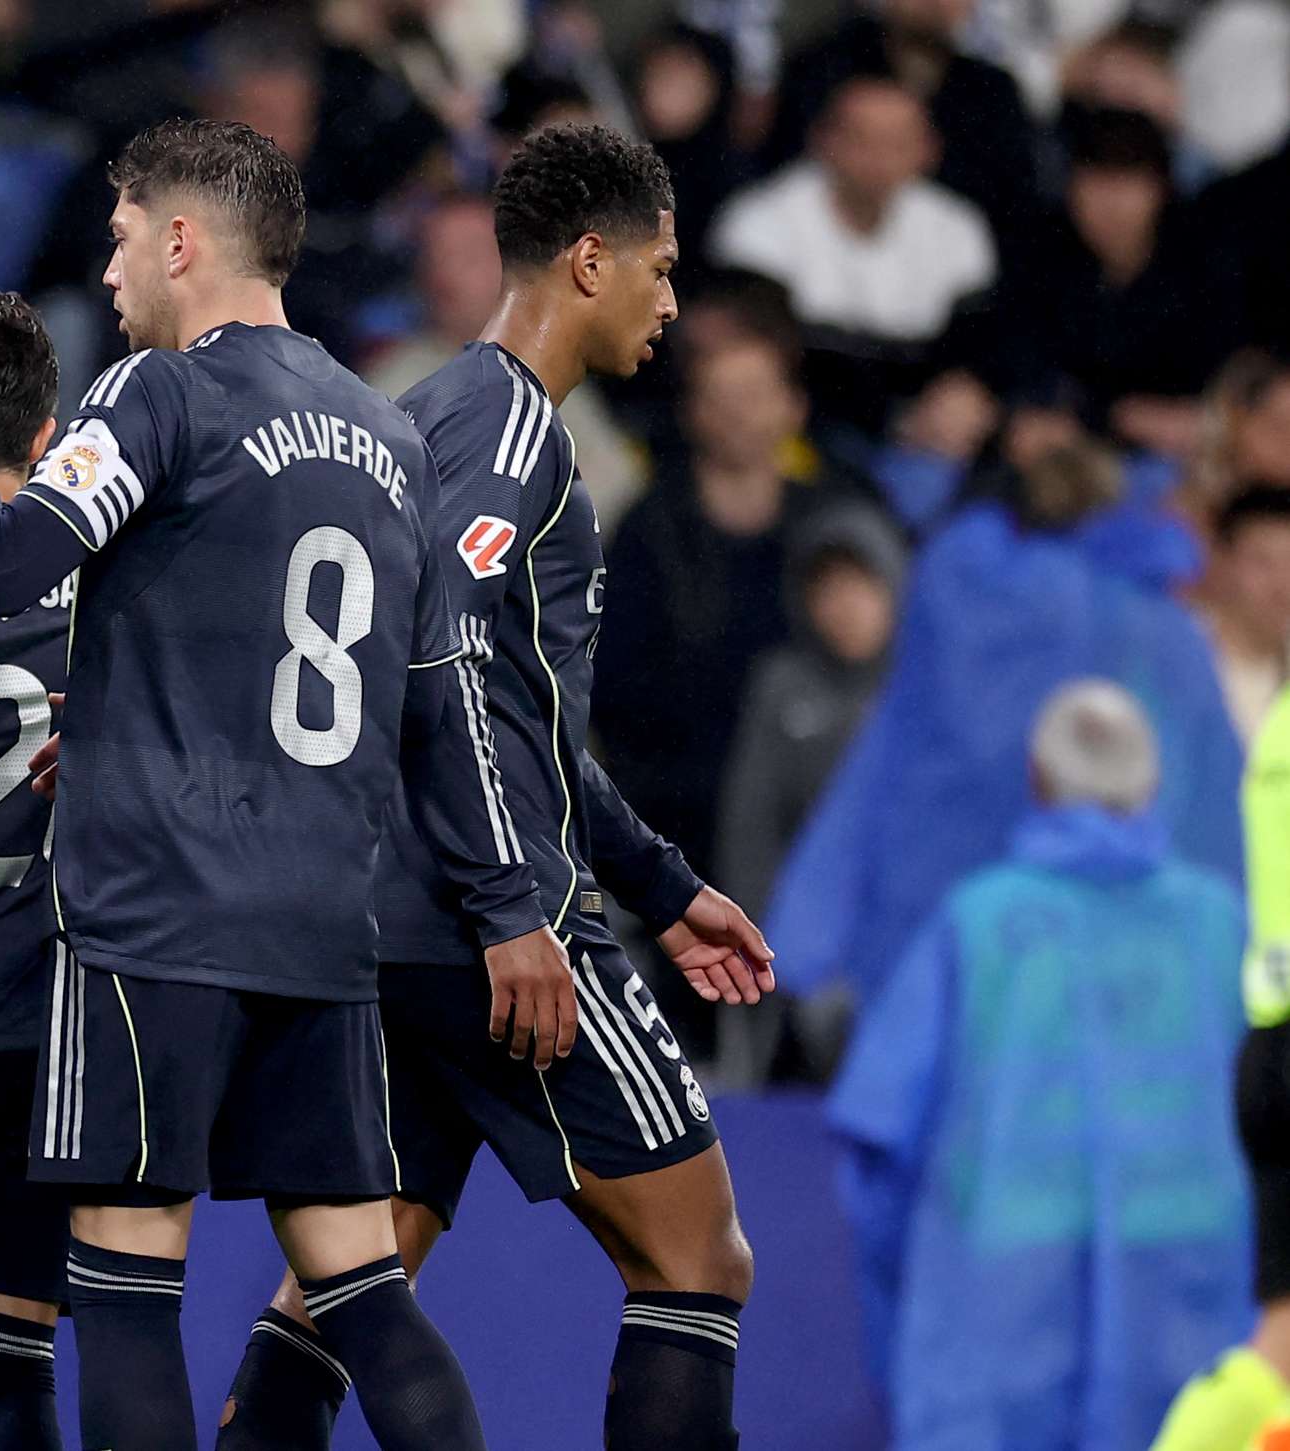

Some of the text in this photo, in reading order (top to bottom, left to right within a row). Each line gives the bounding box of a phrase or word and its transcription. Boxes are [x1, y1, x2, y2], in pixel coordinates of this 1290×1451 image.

[242, 410, 409, 511] VALVERDE
[270, 525, 374, 767] 8
[624, 971, 681, 1060] 5
